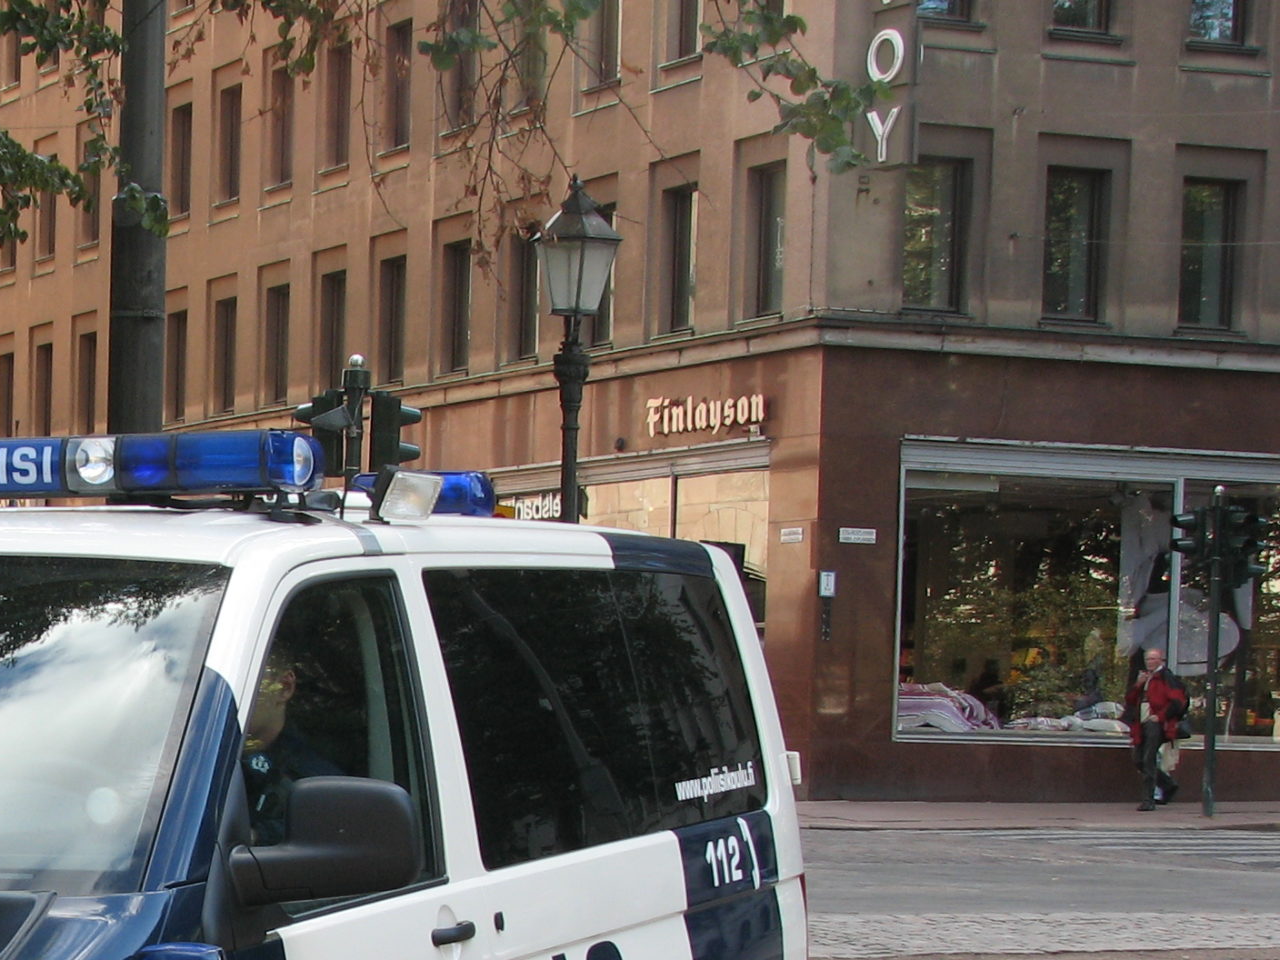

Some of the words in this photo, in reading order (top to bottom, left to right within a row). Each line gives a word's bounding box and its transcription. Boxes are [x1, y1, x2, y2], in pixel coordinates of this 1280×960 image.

[867, 0, 902, 162] OY
[646, 394, 765, 438] Finlayson
[705, 836, 743, 887] 112
